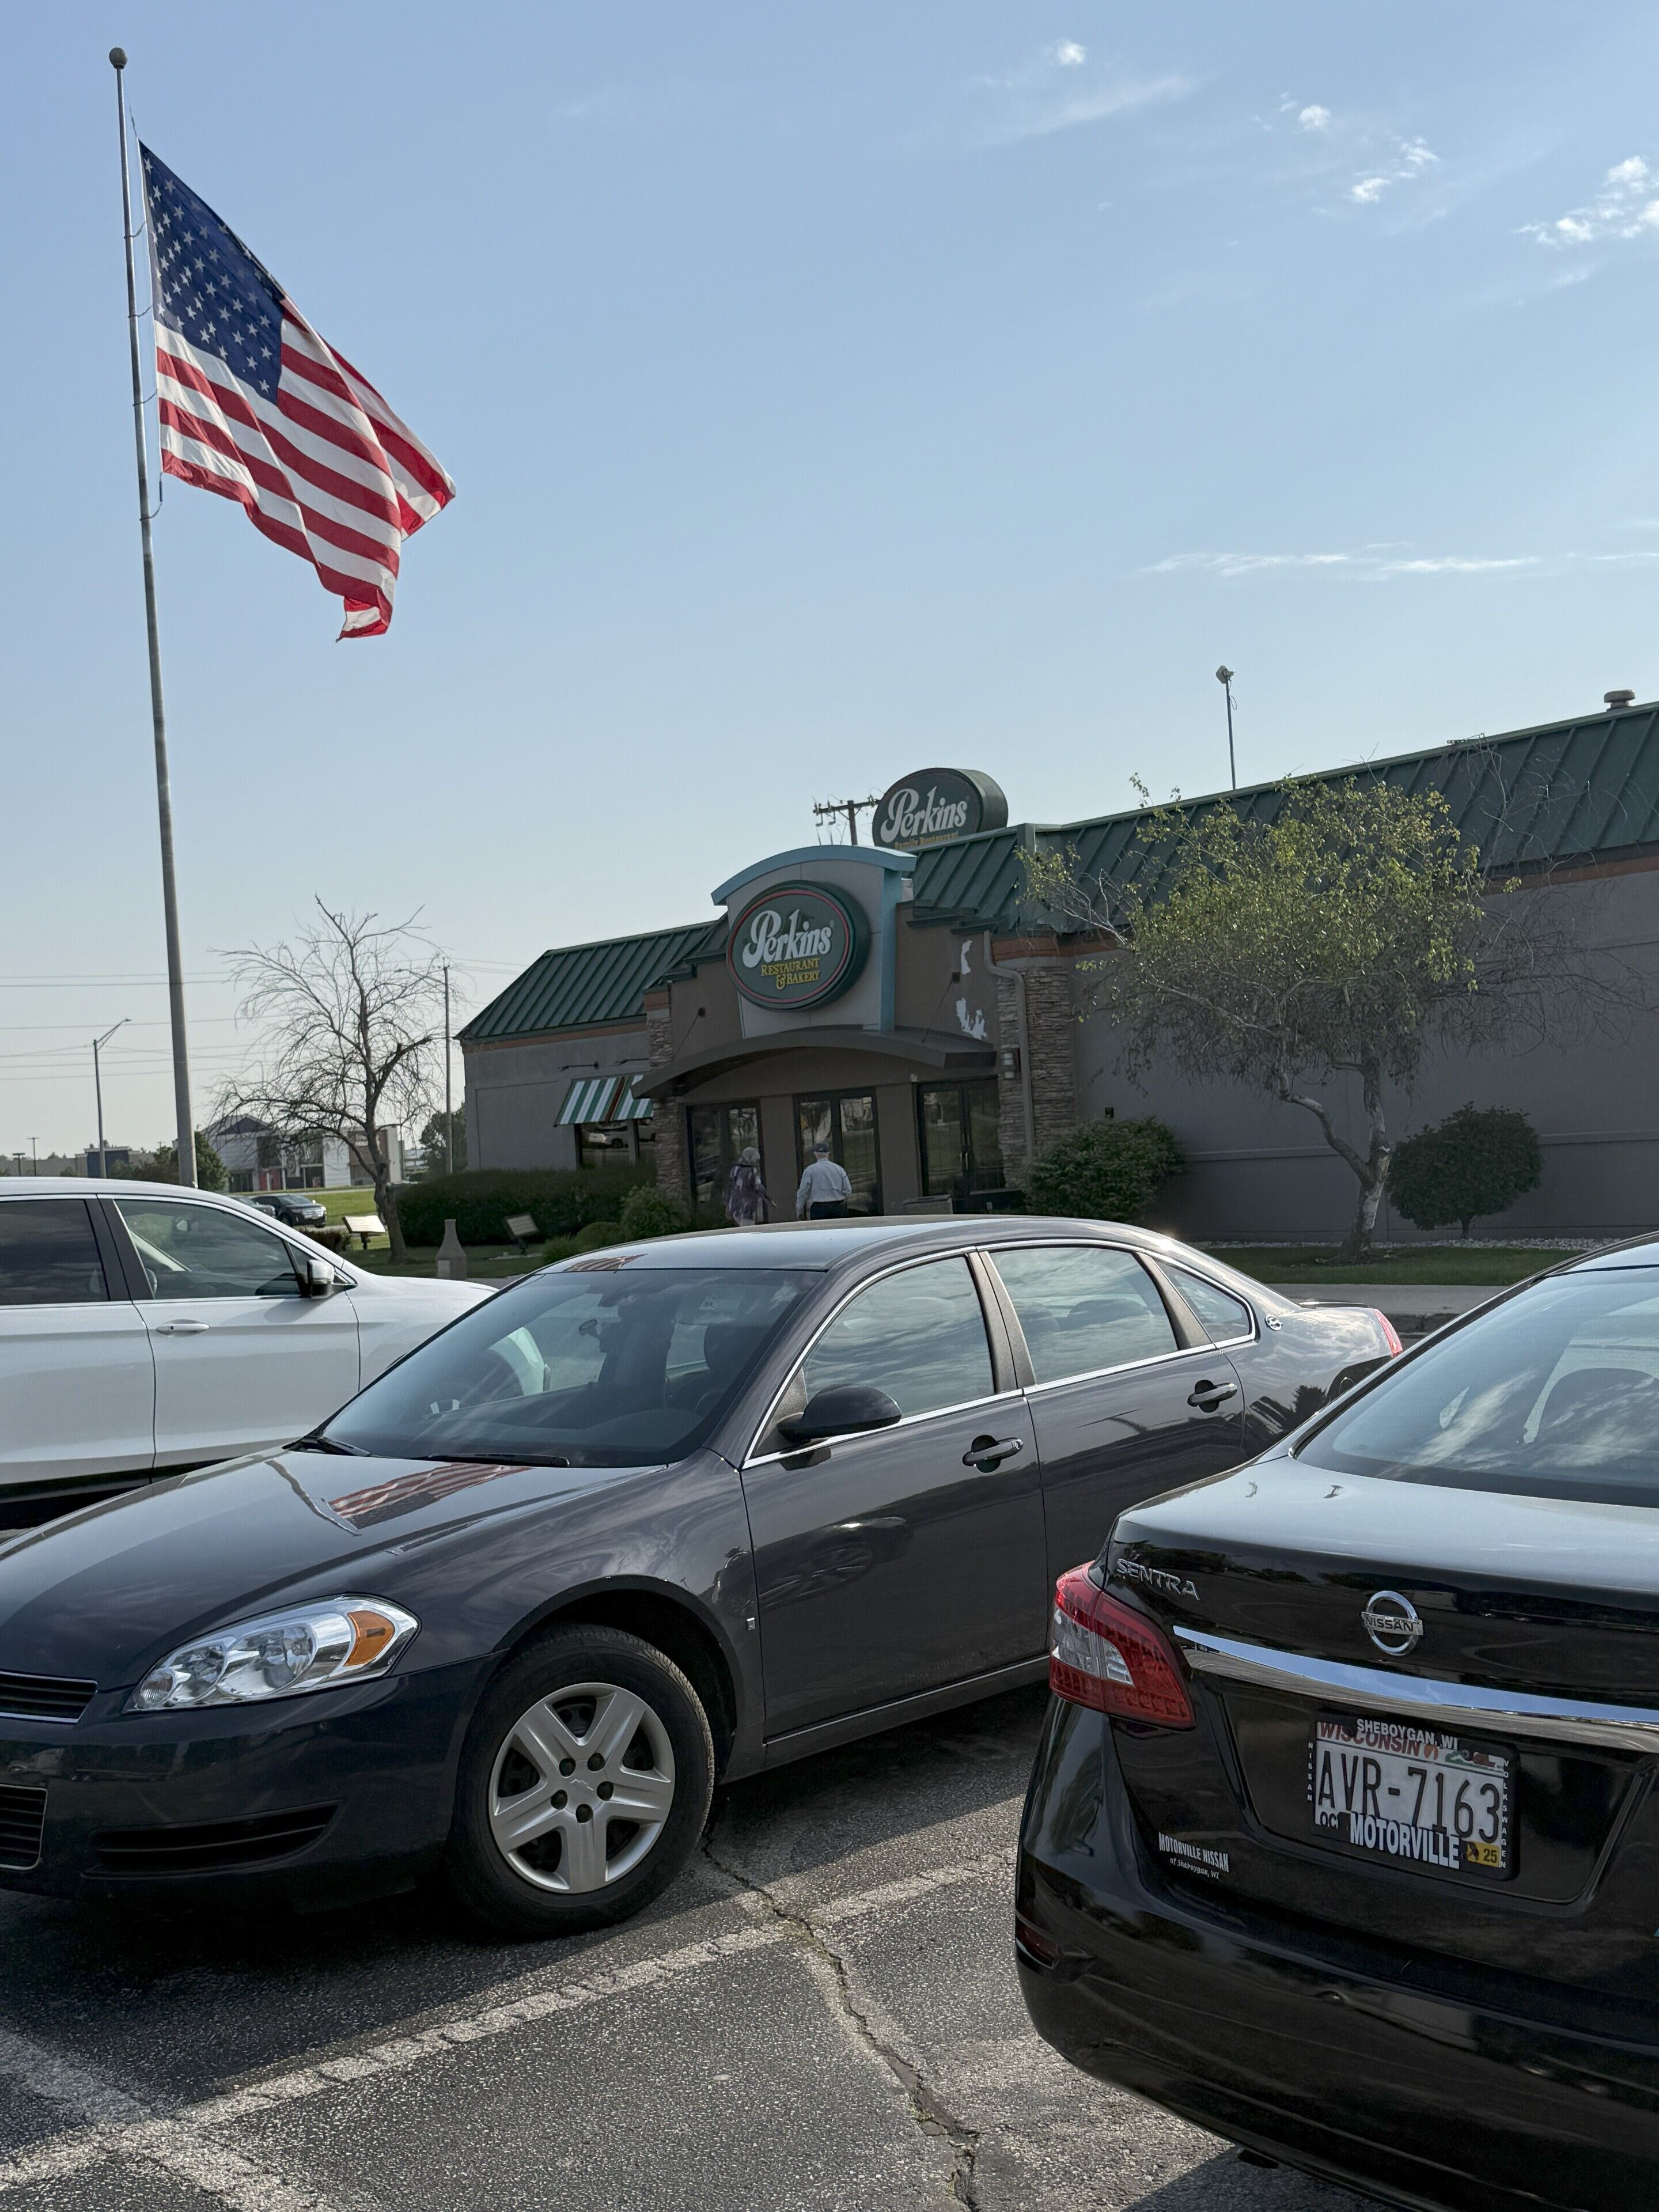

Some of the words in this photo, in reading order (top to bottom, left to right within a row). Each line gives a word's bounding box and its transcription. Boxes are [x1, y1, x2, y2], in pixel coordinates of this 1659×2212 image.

[880, 786, 967, 843] Perkins
[742, 908, 832, 968] Perkins
[761, 958, 820, 976] RESTAURANT
[1116, 1558, 1200, 1601] SENTRA
[1365, 1615, 1414, 1632] NISSAN
[1357, 1718, 1437, 1744] SHEBOYGAN,
[1441, 1734, 1458, 1749] WI
[1318, 1750, 1500, 1843] AVR-7163
[1500, 1759, 1509, 1869] VOLKSWAGEN
[1158, 1832, 1201, 1861] MOTORVILLE
[1202, 1849, 1229, 1873] NISSAN
[1169, 1858, 1176, 1866] of
[1350, 1813, 1460, 1869] MOTORVILLE
[1483, 1848, 1498, 1863] 25
